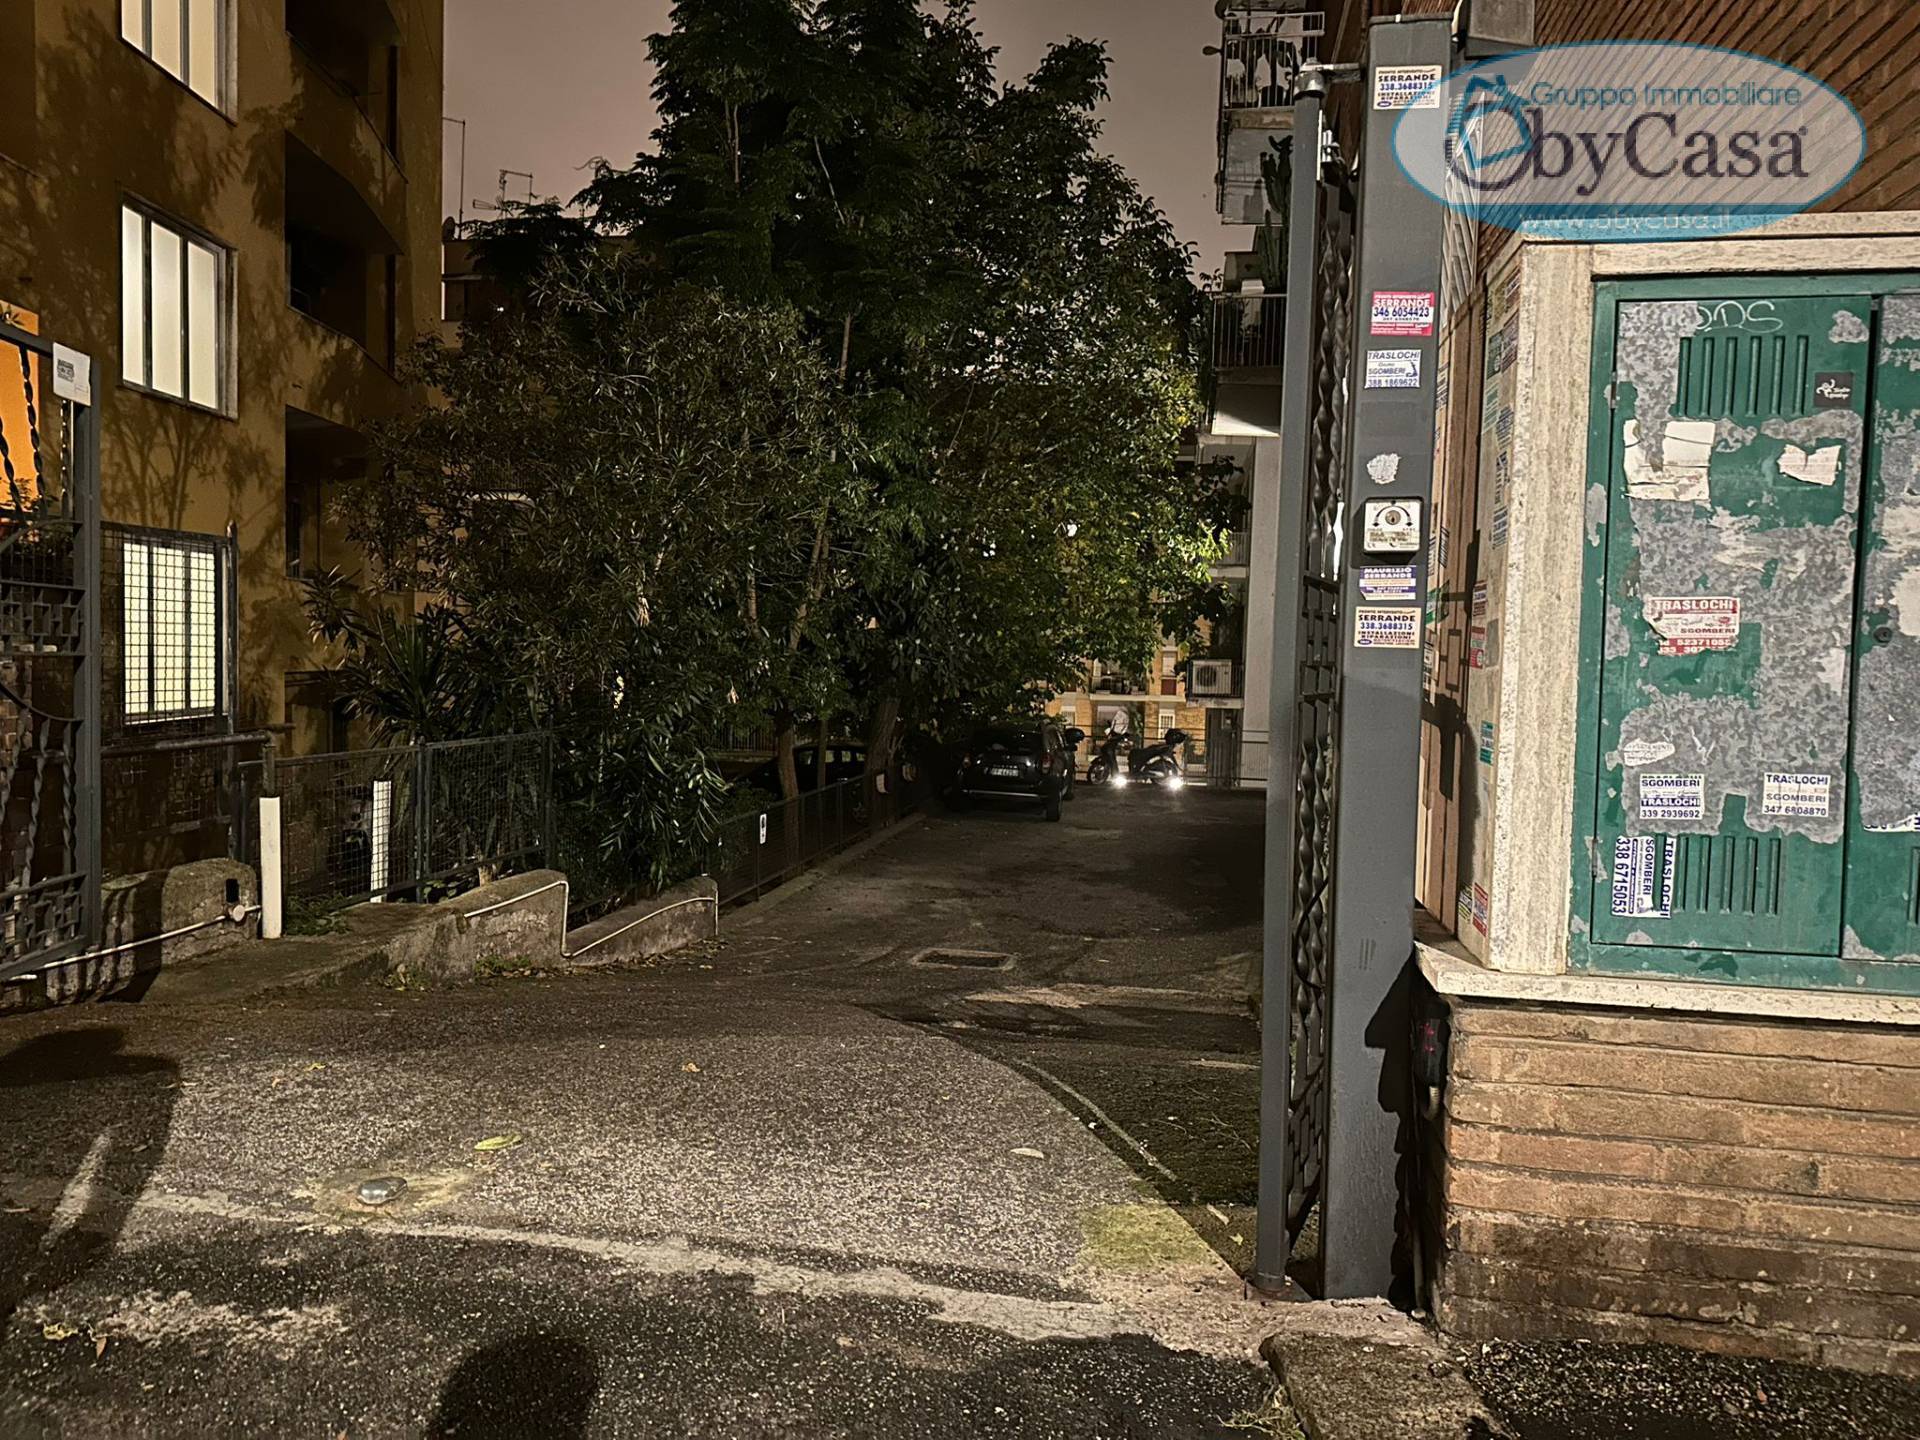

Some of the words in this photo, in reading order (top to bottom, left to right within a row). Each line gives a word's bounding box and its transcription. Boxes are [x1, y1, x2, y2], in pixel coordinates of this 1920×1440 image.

[1378, 74, 1436, 82] SERRANDE
[1374, 299, 1431, 307] SERRANDE
[1374, 307, 1389, 317] 346
[1392, 307, 1430, 317] 6054423
[1654, 600, 1733, 610] TRASLOCHI
[1766, 794, 1826, 802] SGOMBERI
[1661, 810, 1700, 818] 2939692
[1616, 838, 1630, 859] 338
[1642, 839, 1654, 895] SGOMBERI
[1660, 841, 1674, 916] TRASLOCHI
[1612, 863, 1629, 913] 6715053
